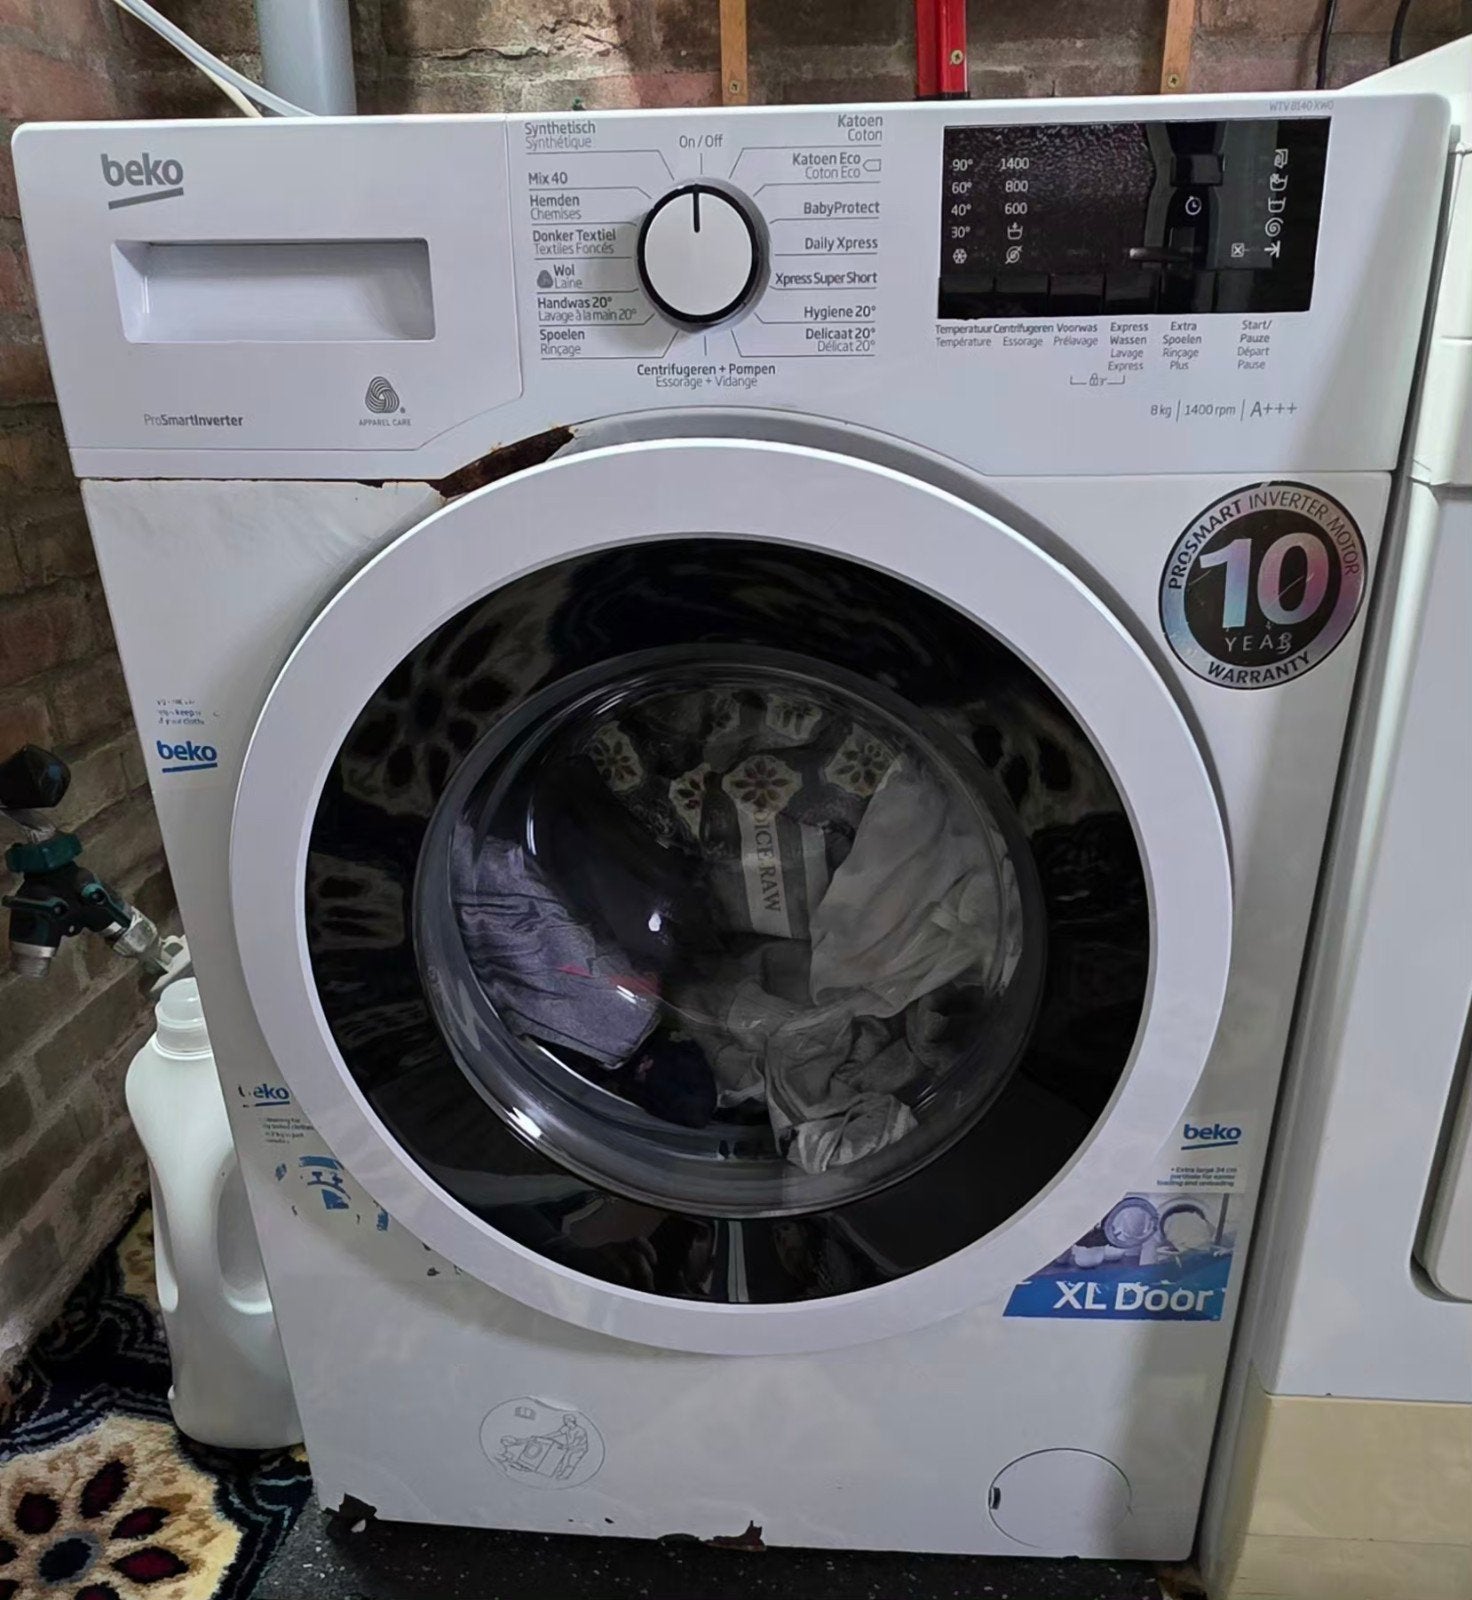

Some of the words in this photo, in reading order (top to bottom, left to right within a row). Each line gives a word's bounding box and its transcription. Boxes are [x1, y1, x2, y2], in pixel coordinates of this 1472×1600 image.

[837, 114, 883, 128] Katoen
[524, 120, 596, 138] Synthetisch
[847, 128, 882, 141] Coton
[525, 135, 592, 151] Synthétique
[679, 134, 695, 148] On
[705, 133, 723, 148] Off
[792, 152, 837, 166] Katoen
[839, 152, 861, 165] Eco
[952, 158, 973, 171] 90°
[1000, 157, 1029, 170] 1400
[101, 152, 184, 187] beko
[805, 166, 839, 180] Coton
[841, 166, 861, 179] Eco
[528, 172, 550, 185] Mix
[551, 171, 568, 184] 40
[951, 181, 973, 194] 60°
[1005, 180, 1029, 193] 800
[529, 194, 580, 207] Hemden
[530, 207, 582, 220] Chemises
[803, 201, 880, 217] BabyProtect
[951, 203, 972, 216] 40°
[1004, 202, 1028, 215] 600
[532, 229, 574, 242] Donker
[575, 228, 616, 241] Textiel
[951, 226, 971, 239] 30°
[535, 243, 574, 255] Textiles
[576, 242, 615, 254] Foncés
[805, 237, 834, 252] Daily
[836, 237, 878, 251] Xpress
[553, 264, 575, 276] Wol
[554, 277, 583, 289] Laine
[775, 272, 813, 287] Xpress
[813, 272, 846, 286] Super
[846, 271, 878, 284] Short
[537, 296, 590, 309] Handwas
[592, 296, 613, 308] 20°
[538, 310, 574, 323] Lavage
[575, 308, 582, 321] à
[583, 309, 592, 321] la
[592, 309, 617, 321] main
[618, 308, 637, 320] 20°
[804, 305, 854, 321] Hygiene
[855, 305, 876, 318] 20°
[935, 324, 992, 335] Temperatuur
[993, 323, 1054, 335] Centrifugeren
[1056, 323, 1098, 333] Voorwas
[1110, 322, 1149, 333] Express
[1170, 321, 1197, 331] Extra
[1242, 319, 1273, 331] Start/
[540, 329, 585, 344] Spoelen
[805, 327, 854, 340] Delicaat
[854, 327, 876, 339] 20°
[1110, 335, 1147, 345] Wassen
[1162, 334, 1202, 346] Spoelen
[1239, 333, 1270, 343] Pauze
[817, 339, 854, 352] Délicat
[855, 339, 876, 352] 20°
[935, 336, 992, 348] Température
[1002, 336, 1044, 348] Essorage
[1053, 336, 1099, 347] Prélavage
[540, 343, 582, 357] Rinçage
[1110, 348, 1144, 360] Lavage
[1162, 347, 1199, 360] Rinçage
[1237, 346, 1270, 357] Départ
[637, 362, 717, 377] Centrifugeren
[718, 364, 727, 373] +
[729, 363, 776, 377] Pompen
[1107, 361, 1144, 372] Express
[1170, 360, 1189, 370] Plus
[1237, 360, 1266, 369] Pause
[656, 376, 703, 390] Essorage
[715, 376, 758, 389] Vidange
[1150, 404, 1158, 416] 8
[1158, 404, 1172, 418] kg
[1184, 404, 1214, 416] 1400
[1214, 406, 1236, 418] rpm
[1250, 401, 1297, 417] A+++
[143, 413, 243, 426] ProSmartInverter
[359, 418, 391, 426] APPAREL
[392, 418, 411, 426] CARE
[1168, 499, 1242, 589] PROSMART
[1249, 490, 1330, 523] INVERTER
[1326, 517, 1360, 575] MOTOR
[1200, 532, 1329, 628] 10
[1208, 651, 1310, 683] WARRANTY
[156, 740, 218, 761] beko
[759, 866, 781, 912] RAW
[1183, 1123, 1242, 1140] beko
[1053, 1281, 1107, 1310] XL
[1114, 1281, 1215, 1312] Door
